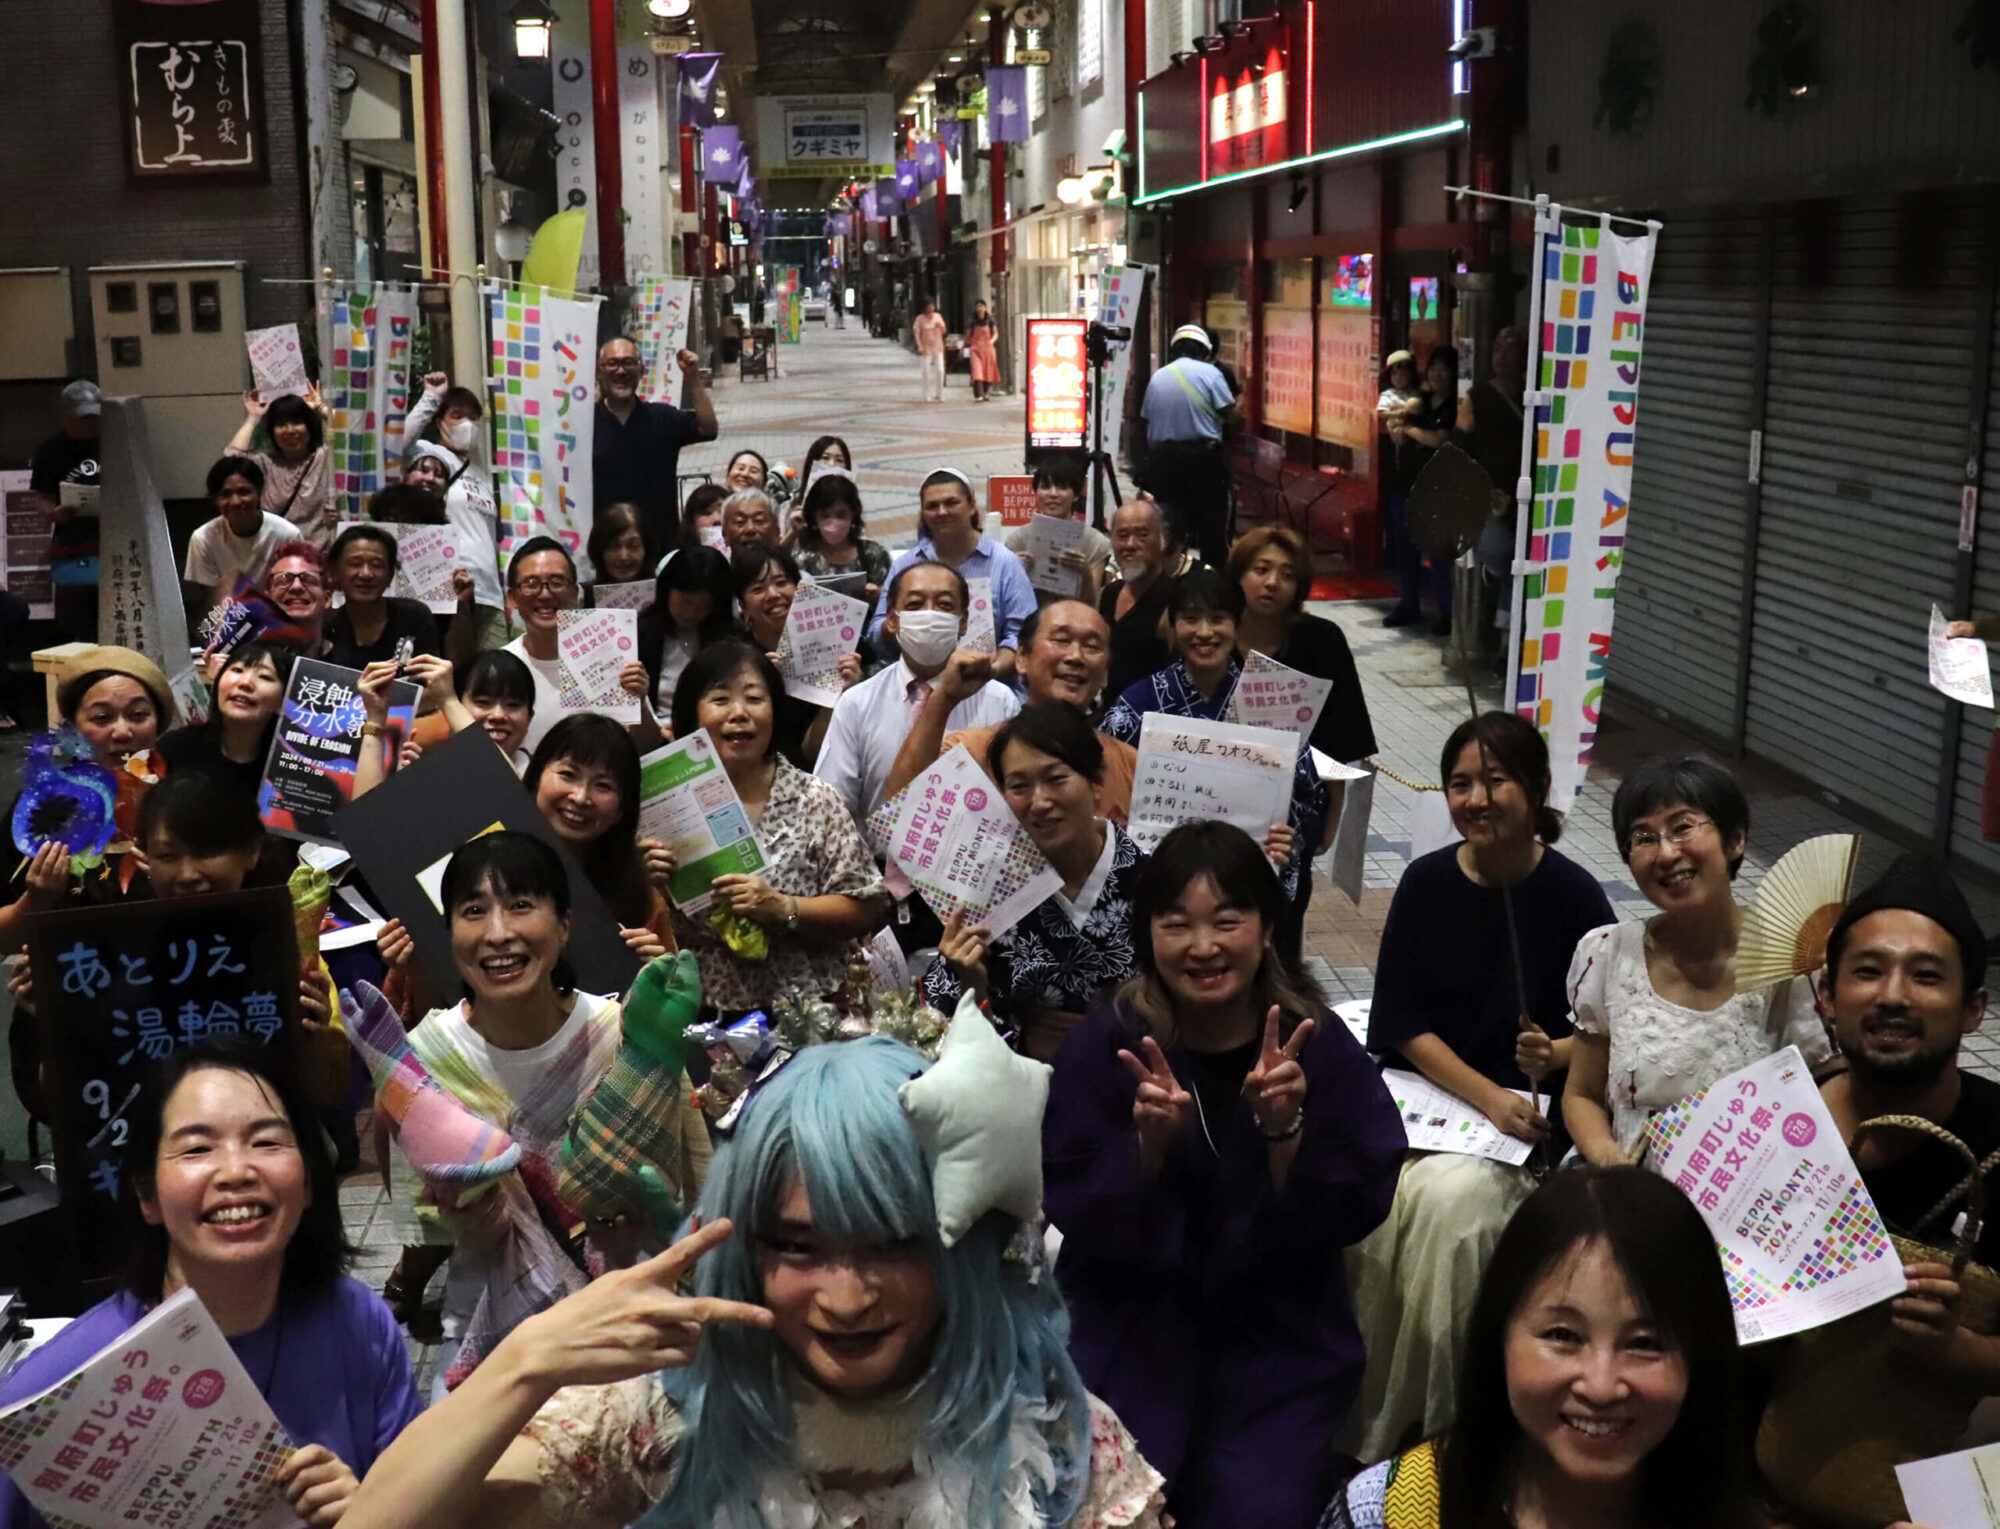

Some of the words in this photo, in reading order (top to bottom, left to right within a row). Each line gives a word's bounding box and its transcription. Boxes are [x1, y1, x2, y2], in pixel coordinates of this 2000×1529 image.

[158, 46, 202, 163] むら上
[792, 139, 861, 156] クギミヤ
[1606, 270, 1642, 466] BEPPU
[1004, 495, 1036, 507] BEPPU
[298, 675, 365, 711] 浸蝕の
[285, 730, 308, 746] DIVIDE
[309, 736, 319, 747] OF
[320, 738, 352, 755] EROSION
[899, 773, 942, 863] 別府町じゅう
[947, 843, 968, 881] BEPPU
[958, 862, 974, 886] ART
[966, 817, 991, 861] MONTH
[969, 863, 985, 890] 2024
[58, 934, 246, 998] あとりえ
[112, 991, 283, 1065] 湯輪夢
[1675, 1080, 1758, 1196] 別府町じゅう
[1697, 1101, 1782, 1211] 市民文化祭。
[1789, 1118, 1808, 1141] 128
[1736, 1187, 1773, 1239] BEPPU
[1751, 1213, 1776, 1247] ART
[1771, 1158, 1814, 1216] MONTH
[1763, 1220, 1794, 1256] 2024
[191, 1376, 214, 1401] 128
[32, 1350, 149, 1493] 別府町じゅう
[69, 1364, 181, 1504] 市民文化祭。
[123, 1464, 173, 1521] BEPPU
[141, 1488, 176, 1525] ART
[170, 1418, 223, 1489] MONTH
[160, 1490, 197, 1529] 2024
